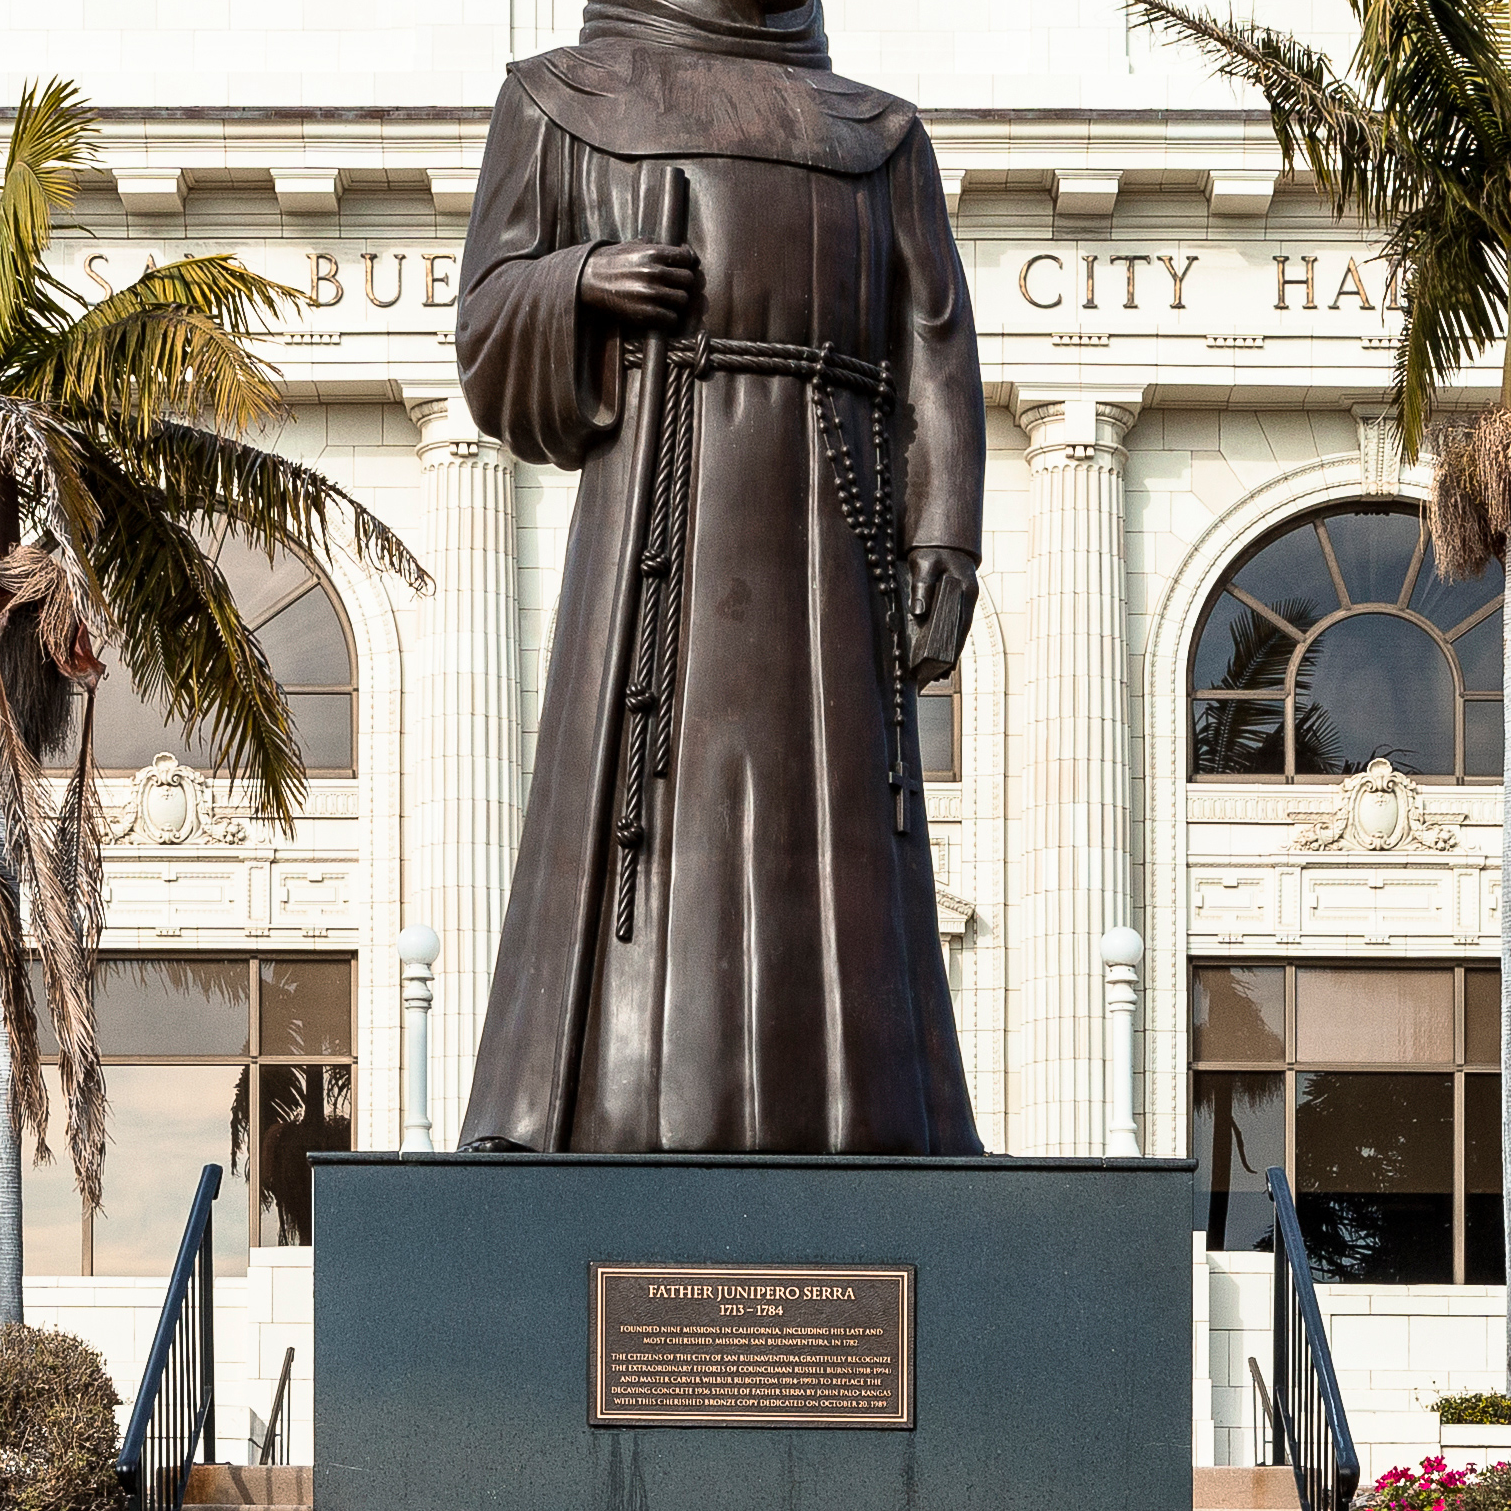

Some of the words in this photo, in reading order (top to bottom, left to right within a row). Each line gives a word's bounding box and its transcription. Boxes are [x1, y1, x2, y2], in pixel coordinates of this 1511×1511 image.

[1019, 254, 1199, 310] CITY
[1273, 254, 1402, 310] HA
[648, 1284, 714, 1299] FATHER
[717, 1285, 800, 1301] JUNIPERO
[803, 1286, 856, 1300] SERRA
[719, 1304, 745, 1316] 1713
[755, 1304, 784, 1316] 1784
[620, 1325, 660, 1333] FOUNDED
[682, 1326, 720, 1334] MISSIONS
[721, 1326, 732, 1334] IN
[783, 1327, 829, 1335] INCLUDING
[830, 1327, 845, 1335] HIS
[846, 1328, 864, 1336] LAST
[864, 1328, 884, 1336] AND
[715, 1337, 749, 1345] MISSION
[611, 1353, 626, 1361] THE
[627, 1353, 663, 1361] CITIZENS
[663, 1353, 674, 1361] OF
[675, 1353, 691, 1361] THE
[711, 1354, 722, 1362] OF
[723, 1354, 738, 1362] SAN
[739, 1354, 800, 1362] BUENAVENTURA
[800, 1355, 846, 1363] GRATEFULLY
[847, 1356, 891, 1364] RECOGNIZE
[611, 1364, 627, 1372] THE
[628, 1364, 692, 1372] EXTRAORDINARY
[693, 1365, 726, 1373] EFFORTS
[726, 1365, 738, 1373] OF
[738, 1366, 793, 1374] COUNCILMAN
[794, 1366, 824, 1374] RUSSELL
[826, 1366, 852, 1374] BURNS
[619, 1375, 639, 1383] AND
[670, 1376, 701, 1384] CARVER
[702, 1376, 733, 1384] WILBUR
[832, 1378, 865, 1386] REPLACE
[865, 1378, 882, 1386] THE
[611, 1386, 651, 1394] DECAYING
[651, 1387, 694, 1395] CONCRETE
[711, 1387, 739, 1395] STATUE
[751, 1388, 781, 1396] FATHER
[781, 1388, 805, 1396] SERRA
[816, 1389, 839, 1397] JOHN
[613, 1397, 636, 1405] WITH
[637, 1397, 656, 1405] THIS
[657, 1398, 704, 1406] CHERISHED
[704, 1398, 736, 1406] BRONZE
[759, 1399, 805, 1407] DEDICATED
[805, 1399, 819, 1407] ON
